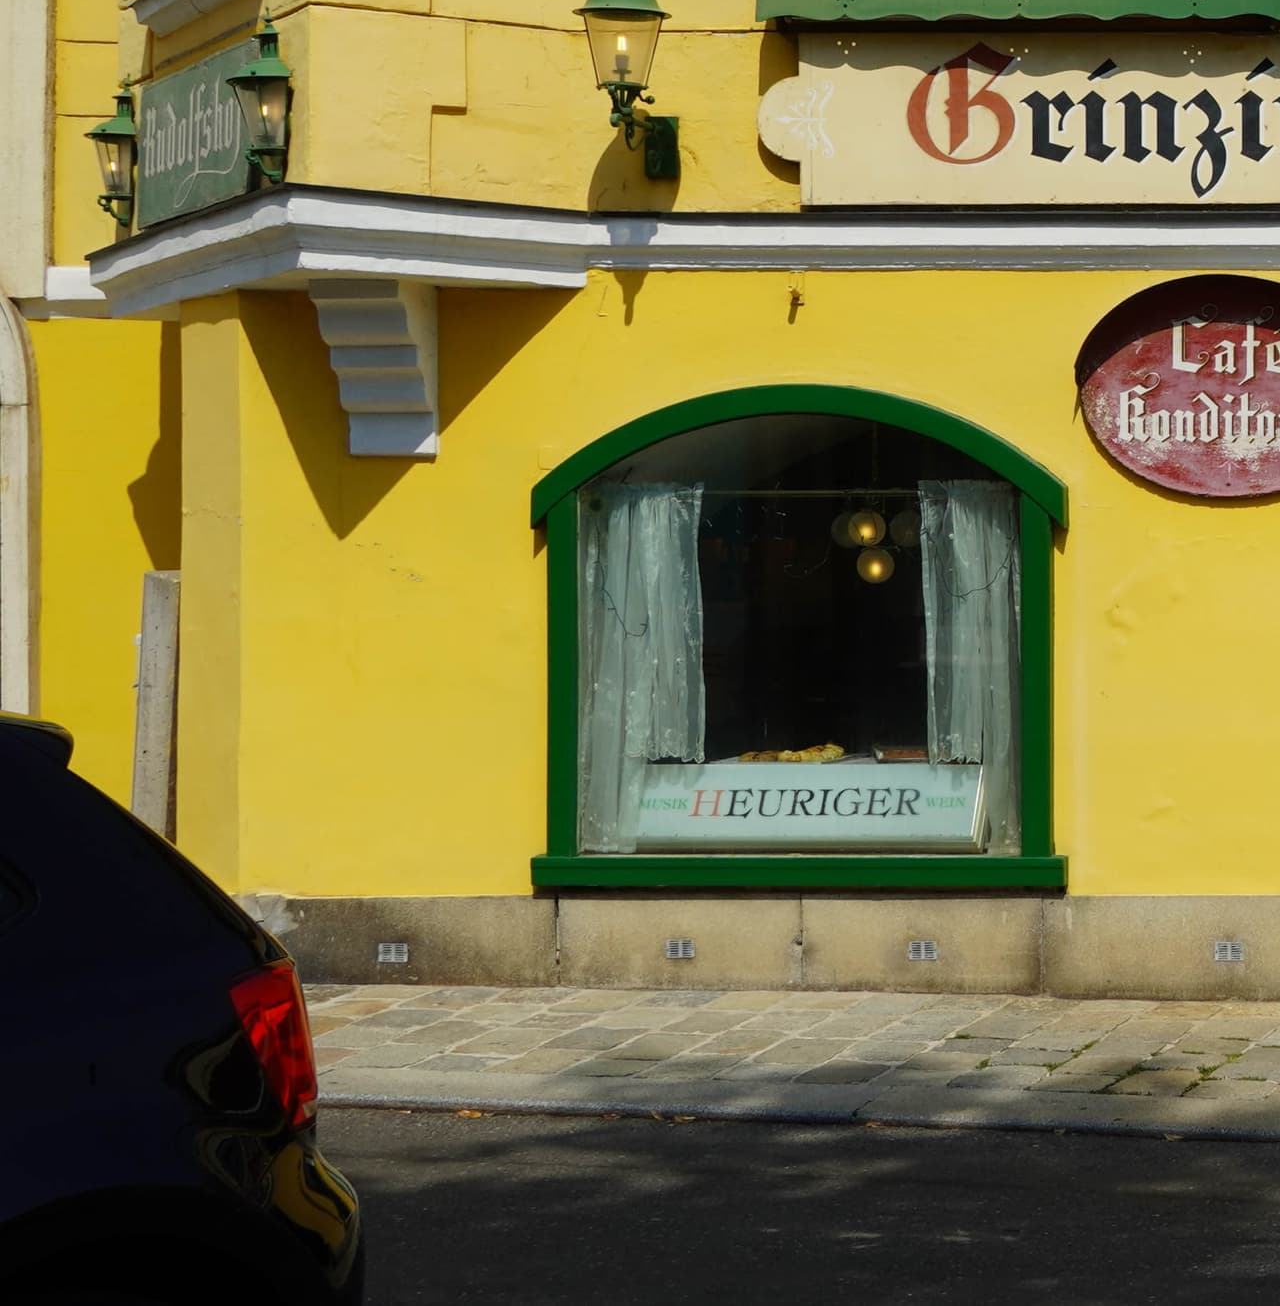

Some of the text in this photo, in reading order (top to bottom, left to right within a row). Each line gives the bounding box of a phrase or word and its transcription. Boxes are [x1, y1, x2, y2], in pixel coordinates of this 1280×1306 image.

[639, 787, 967, 820] MUSIK HEURIGER WEIN
